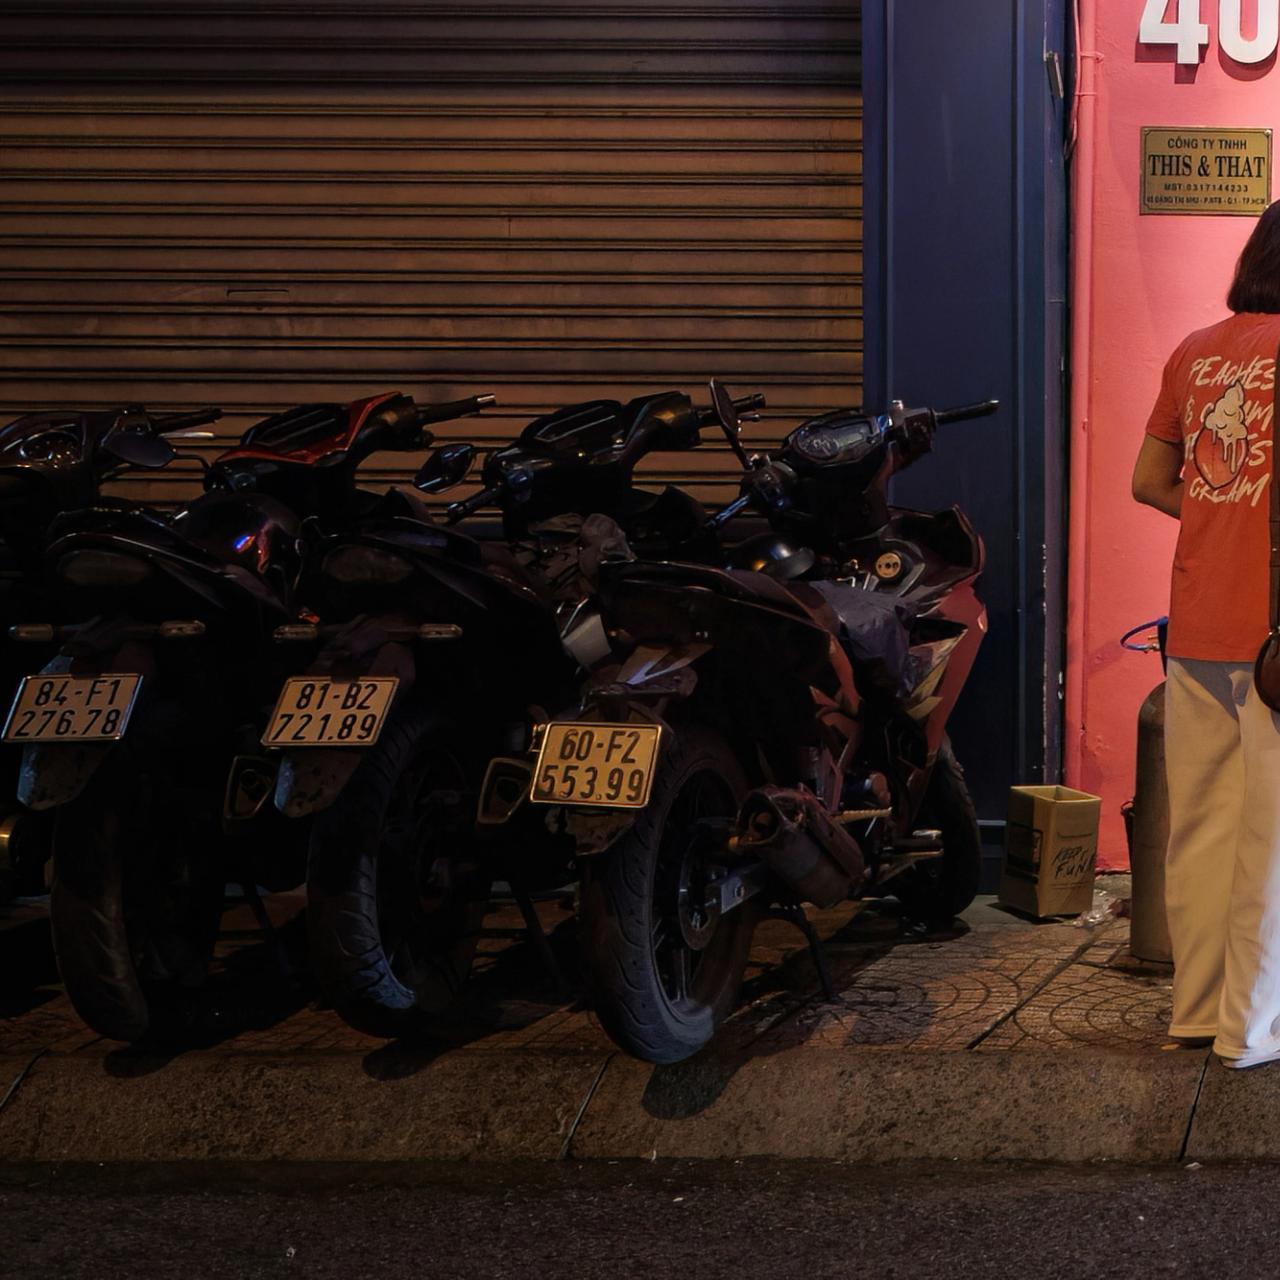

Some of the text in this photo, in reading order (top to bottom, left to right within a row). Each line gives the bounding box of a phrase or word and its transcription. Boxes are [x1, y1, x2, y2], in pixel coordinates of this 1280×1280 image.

[1203, 139, 1217, 150] TY
[1219, 139, 1247, 150] TNHH
[1148, 154, 1265, 178] THIS & THAT
[35, 680, 121, 706] 84-F1
[296, 683, 378, 710] 81-B2
[14, 709, 121, 736] 276.78
[272, 713, 378, 741] 721.89
[560, 729, 641, 763] 60-F2
[541, 765, 645, 801] 553.99
